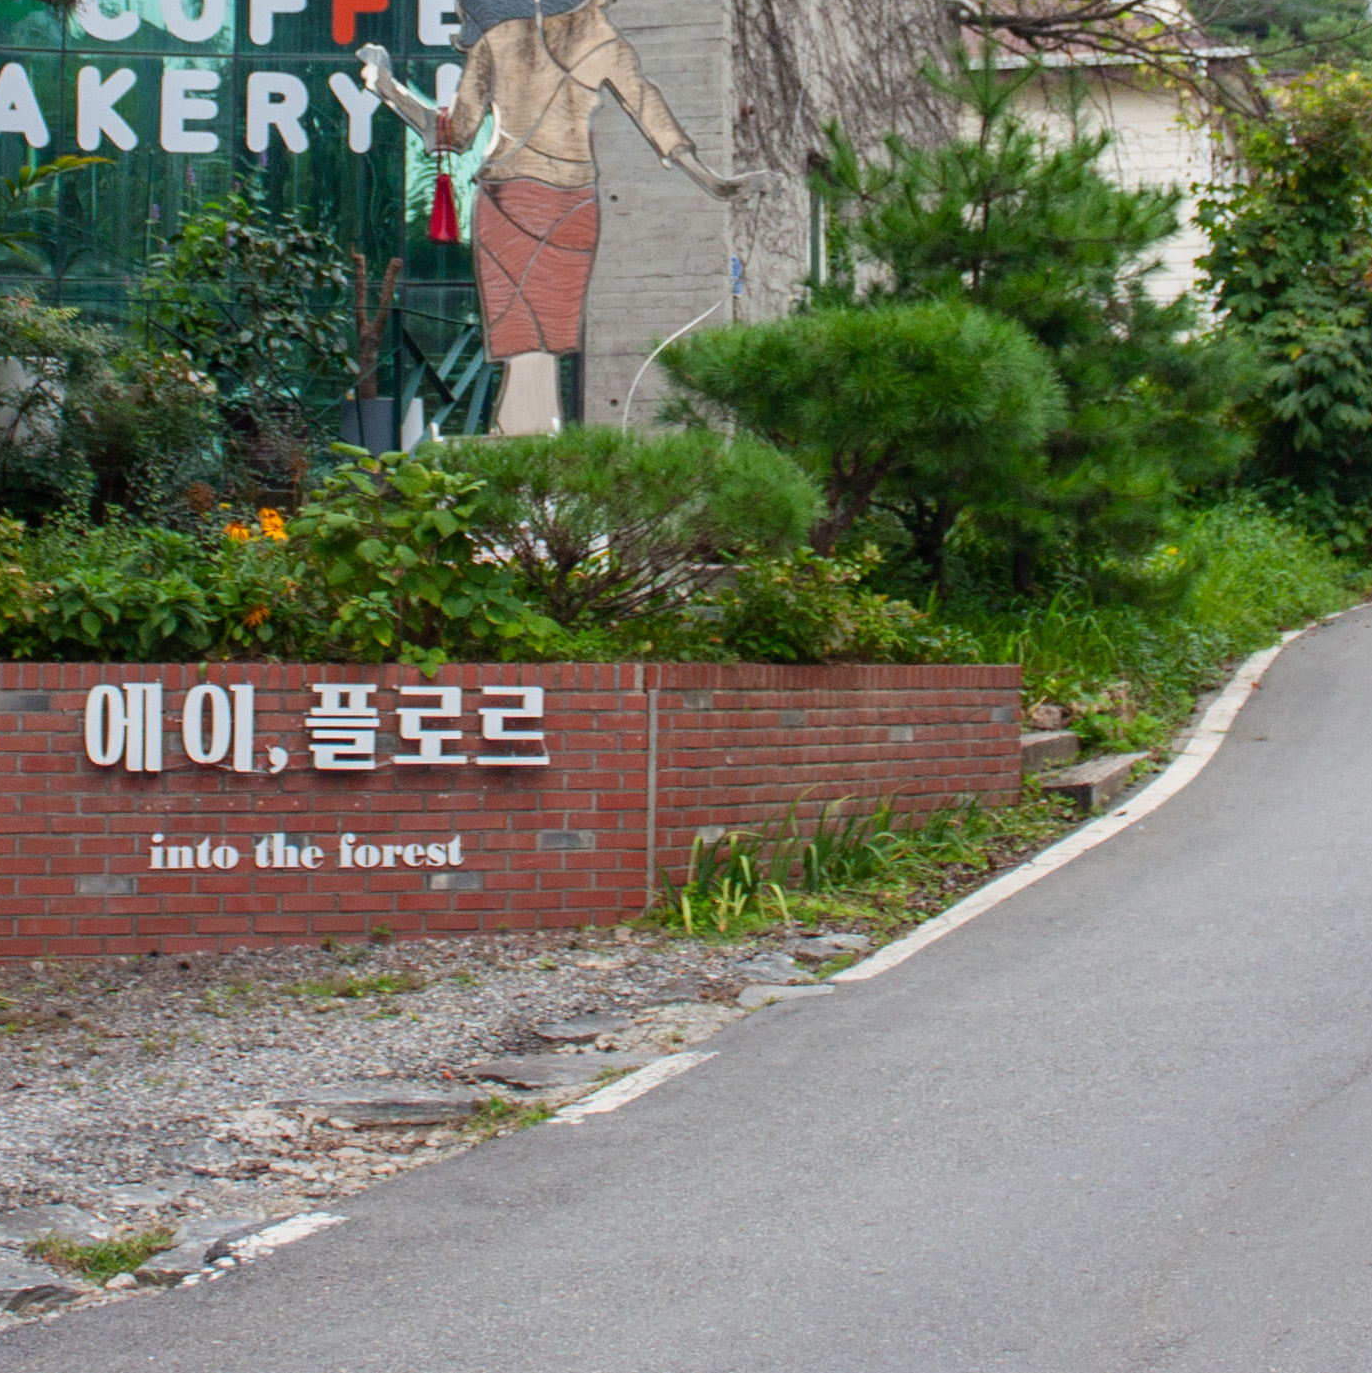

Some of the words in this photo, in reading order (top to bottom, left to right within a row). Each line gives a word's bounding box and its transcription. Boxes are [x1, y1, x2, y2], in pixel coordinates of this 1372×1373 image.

[84, 682, 289, 773] 에이,
[305, 683, 551, 770] 플로르
[148, 833, 240, 871] into
[254, 832, 324, 870] the
[338, 832, 465, 869] forest
